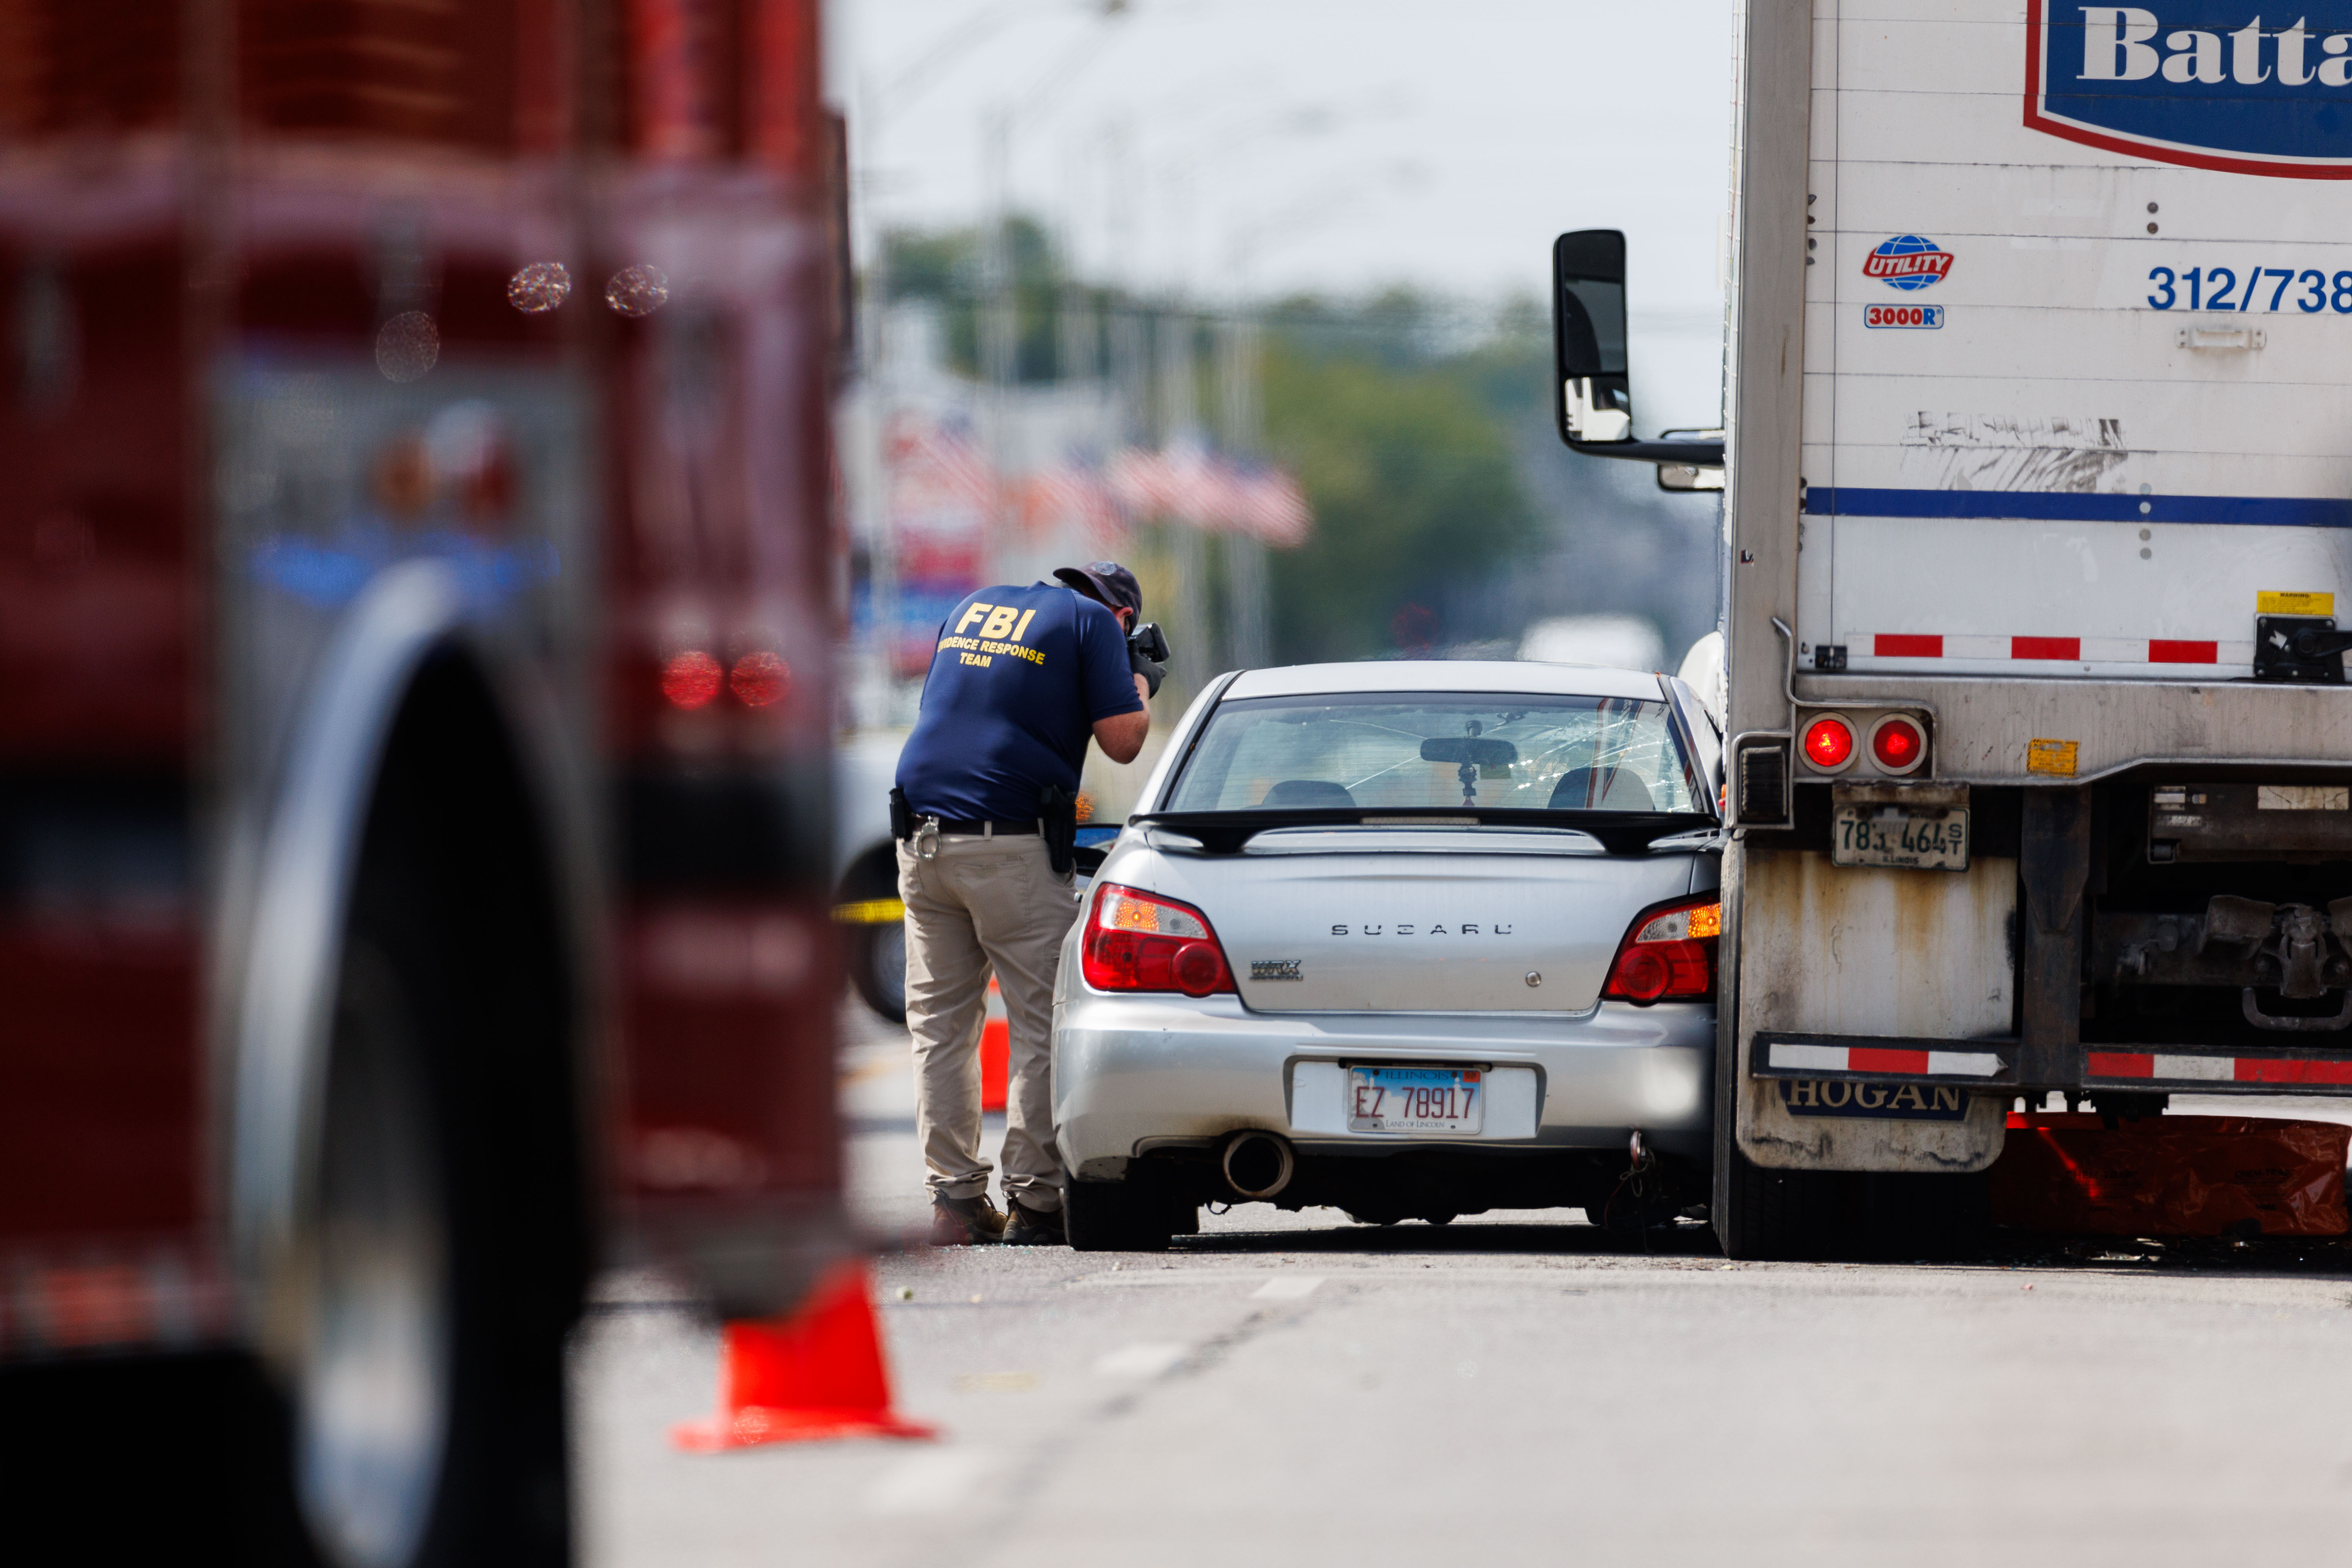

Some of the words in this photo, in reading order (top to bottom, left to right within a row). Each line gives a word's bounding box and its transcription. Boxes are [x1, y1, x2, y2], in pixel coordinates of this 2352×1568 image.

[1869, 254, 1950, 274] UTILITY
[2147, 266, 2352, 314] 312/738
[954, 602, 1036, 642] FBI
[960, 652, 992, 668] TEAM
[980, 640, 1045, 665] RESPONSE
[1901, 822, 1947, 855] 464
[1331, 924, 1512, 935] SUBARU
[1385, 1071, 1449, 1080] ILLINOIS
[1356, 1086, 1385, 1118] EZ
[1402, 1087, 1475, 1119] 78917
[1787, 1080, 1959, 1111] HOGAN
